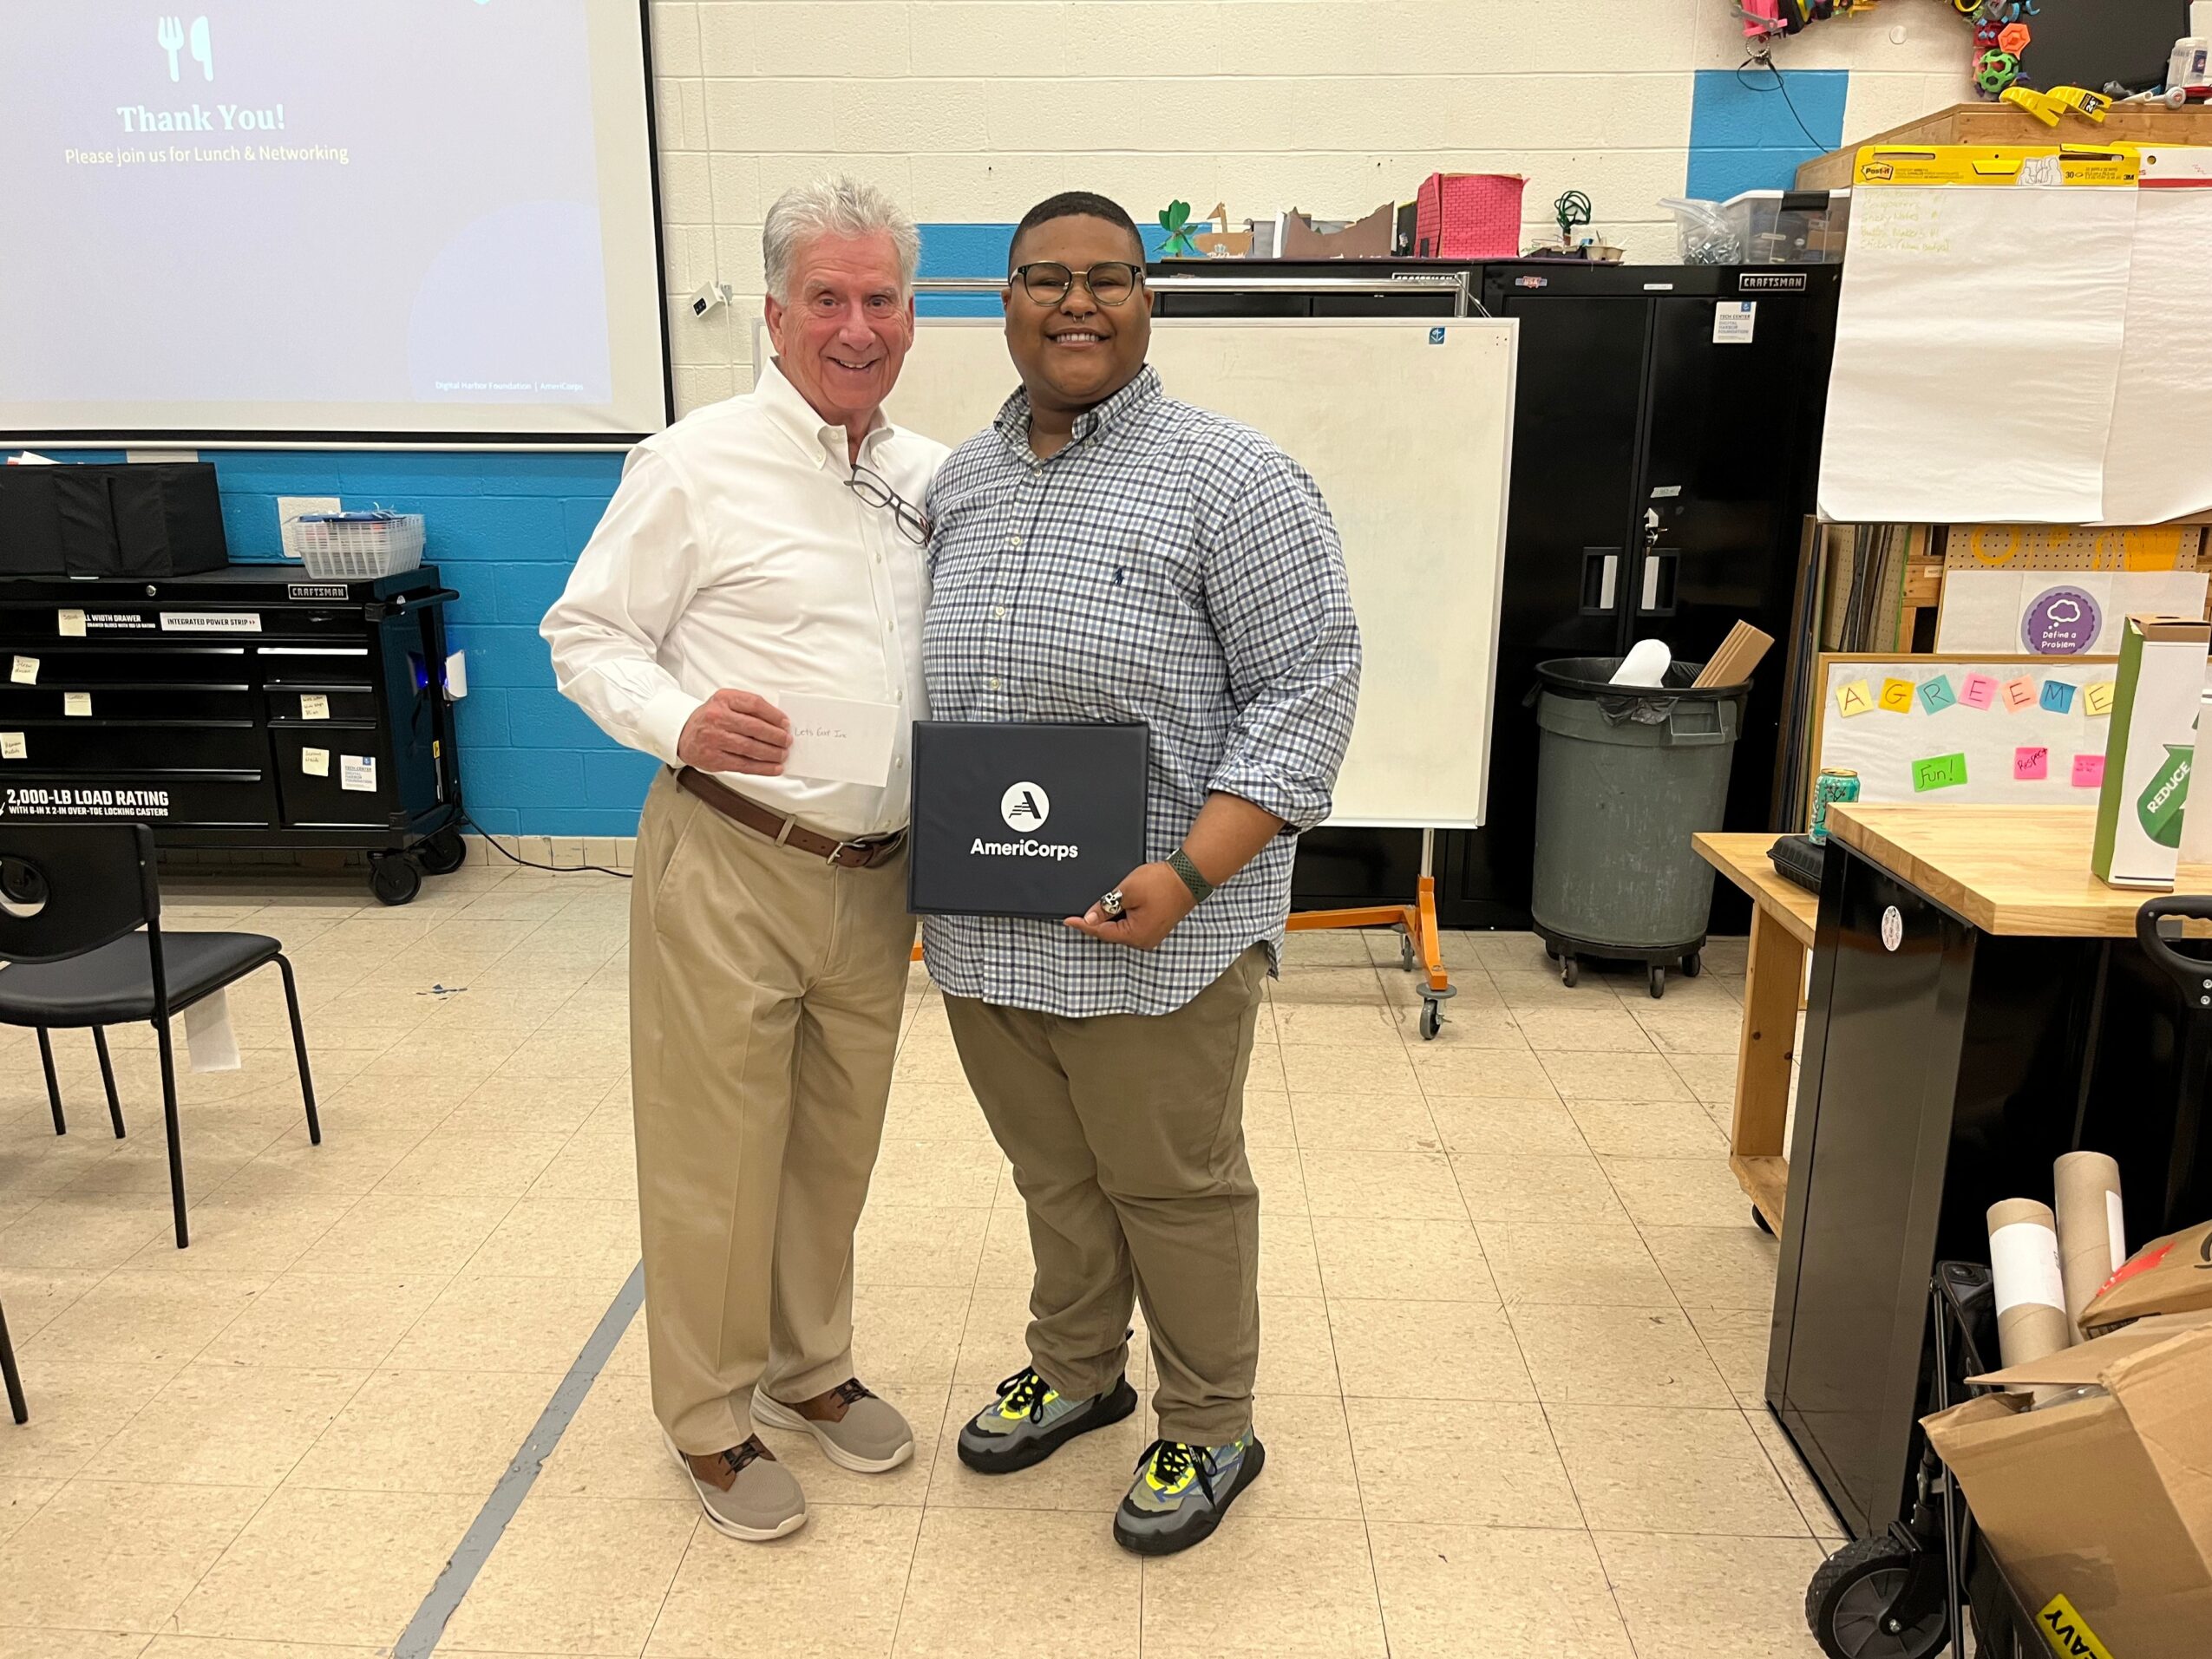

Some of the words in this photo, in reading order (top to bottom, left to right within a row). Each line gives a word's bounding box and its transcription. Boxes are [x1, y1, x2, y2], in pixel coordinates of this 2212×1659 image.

[116, 103, 213, 132] Thank
[218, 103, 285, 131] You!
[65, 148, 114, 164] Please
[116, 147, 145, 167] join
[149, 150, 166, 163] us
[169, 147, 191, 162] for
[194, 146, 240, 162] Lunch
[245, 146, 255, 160] &
[259, 144, 349, 165] Networking
[1744, 278, 1802, 287] CRAFTSMAN
[435, 382, 460, 391] Digital
[461, 382, 488, 390] Harbor
[488, 381, 532, 390] Foundation
[540, 382, 584, 391] AmeriCorps
[291, 587, 344, 597] CRAFTSMAN
[114, 614, 141, 623] DRAWER
[2042, 630, 2069, 639] Define
[2041, 640, 2076, 649] Problem
[2017, 748, 2048, 771] Respect
[1919, 758, 1953, 788] Fun!
[2146, 761, 2191, 813] REDUCE
[6, 788, 72, 807] 2,000-LB
[75, 789, 113, 806] LOAD
[115, 790, 169, 806] RATING
[9, 806, 29, 814] WITH
[68, 807, 103, 815] OVER-TOE
[104, 807, 134, 816] LOCKING
[136, 807, 169, 817] CASTERS
[970, 838, 1079, 861] AmeriCorps
